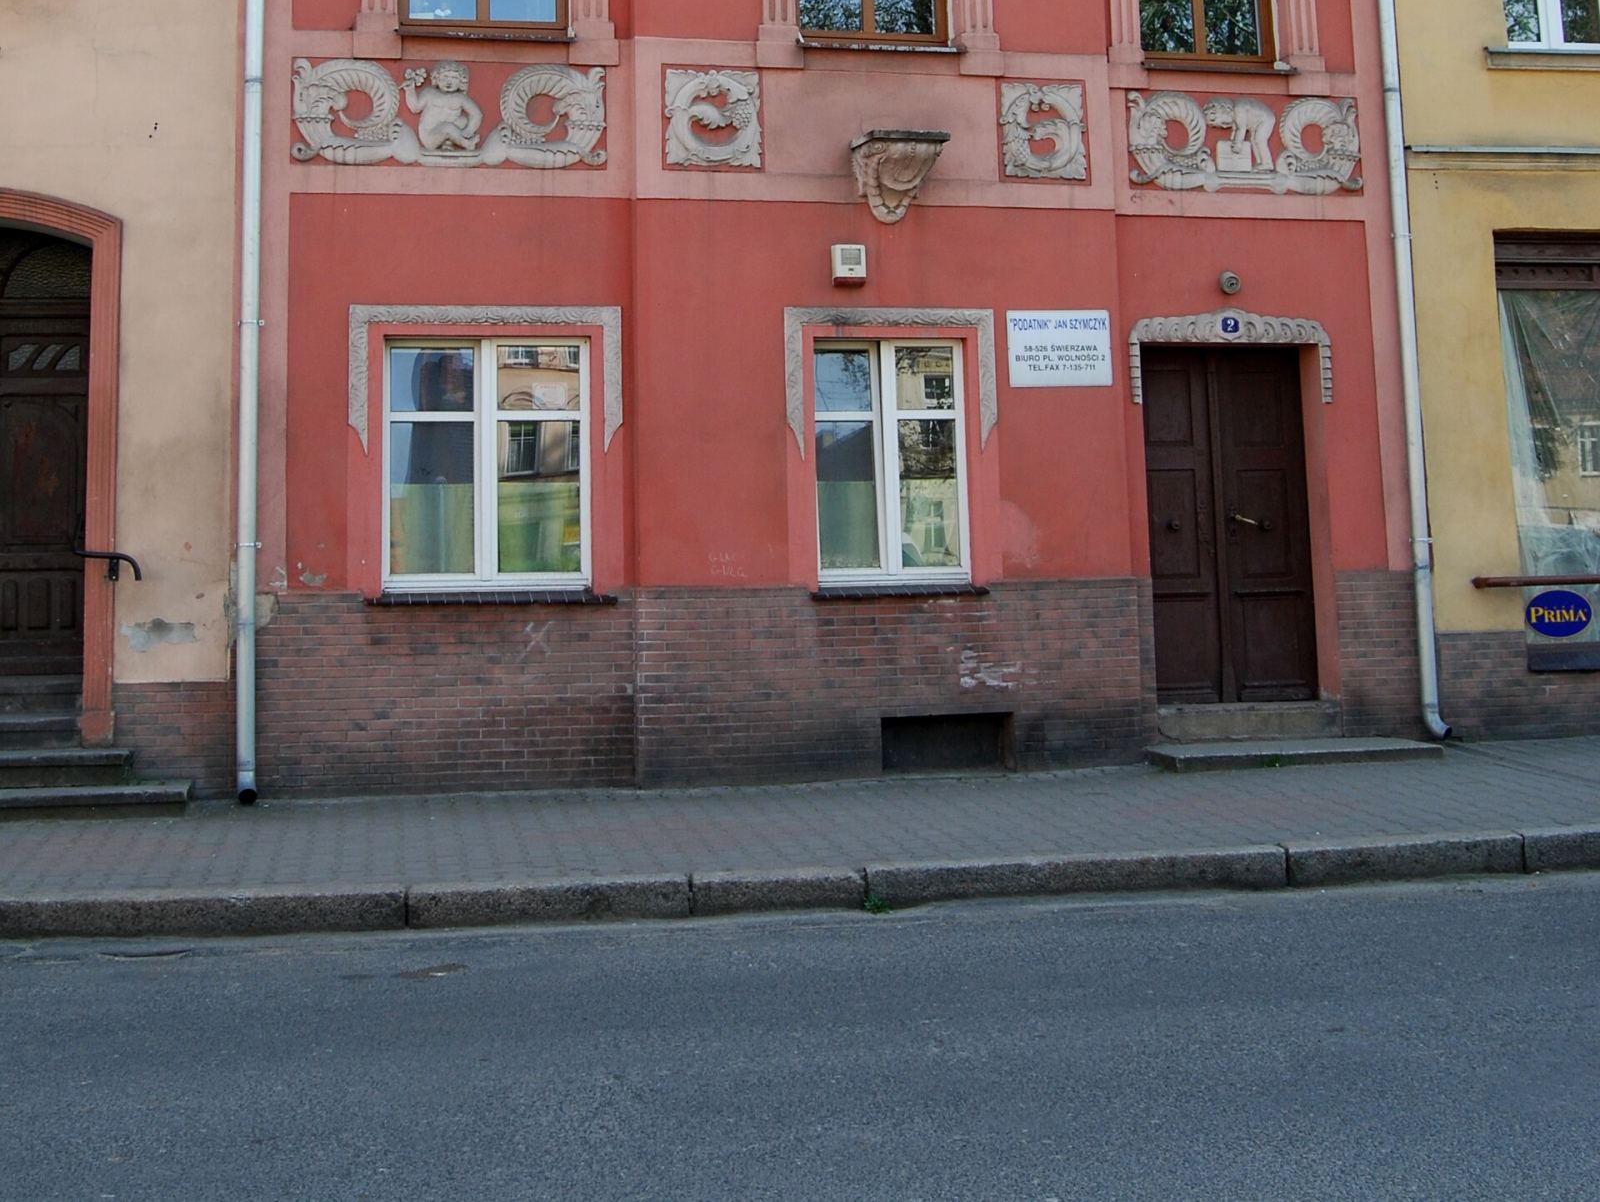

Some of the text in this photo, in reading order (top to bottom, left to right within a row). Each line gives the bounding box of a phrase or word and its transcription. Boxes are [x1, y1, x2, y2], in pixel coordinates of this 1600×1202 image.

[1054, 318, 1068, 330] JAN
[1069, 317, 1108, 330] SZYMCZYK
[1226, 318, 1235, 331] 2
[1050, 344, 1098, 352] ŚWIERZAWA
[1043, 354, 1055, 362] PL.
[1057, 353, 1099, 362] WOLNOŚCI
[1530, 606, 1587, 623] PRIMA
